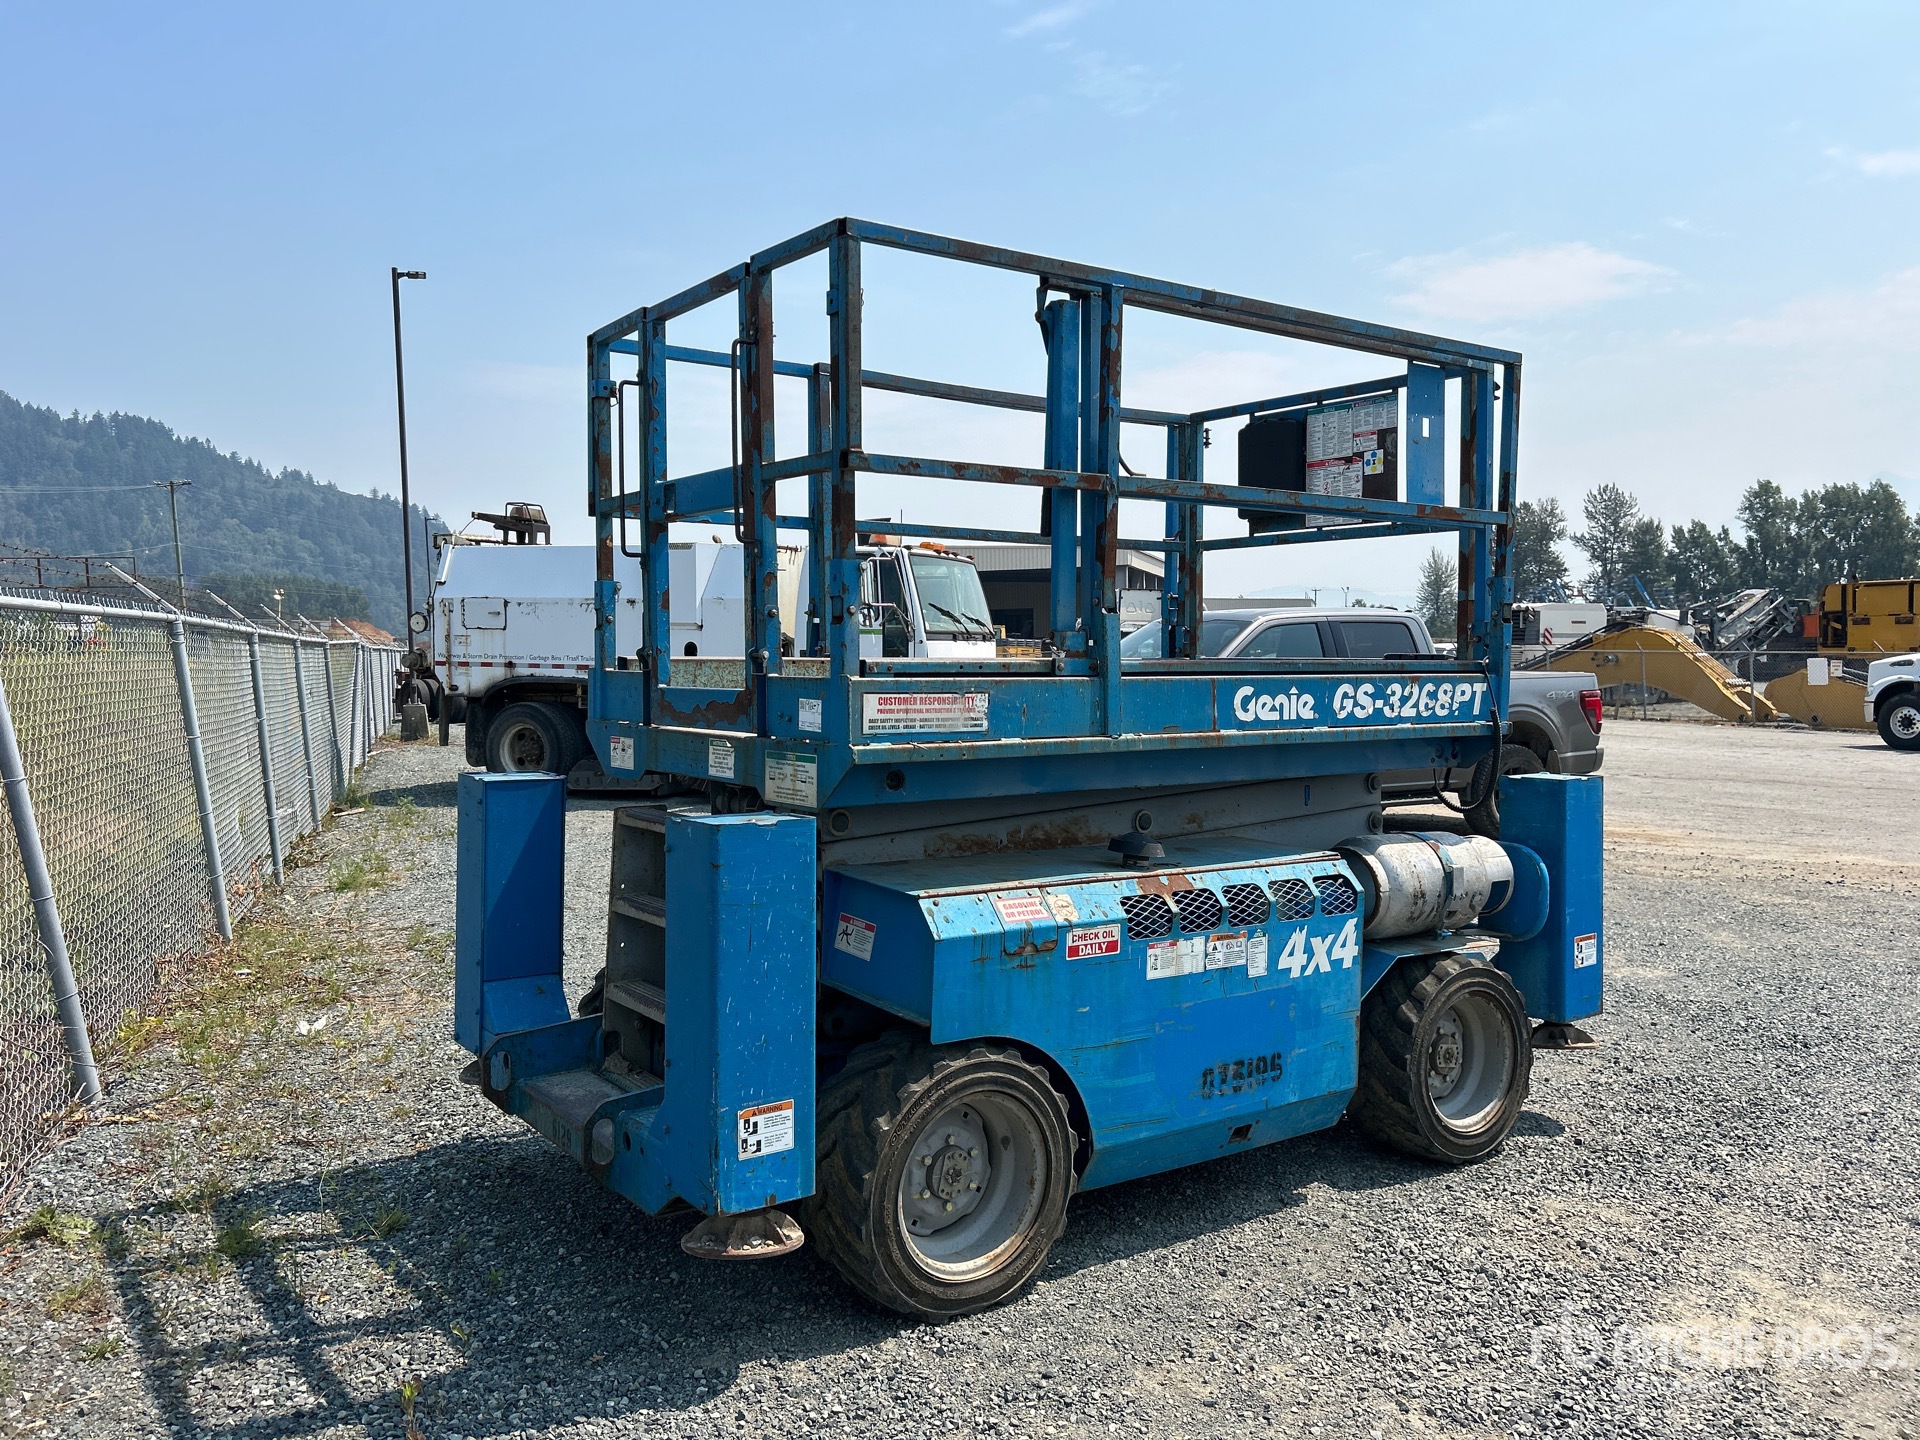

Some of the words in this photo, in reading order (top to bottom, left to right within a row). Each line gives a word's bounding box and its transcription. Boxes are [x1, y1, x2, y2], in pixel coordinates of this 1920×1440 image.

[437, 652, 461, 660] Warway
[498, 653, 525, 661] Protection
[529, 654, 550, 663] Garbage
[878, 696, 918, 706] CUSTOMER
[1233, 685, 1315, 722] Genie
[1002, 900, 1038, 910] GASOLINE
[1017, 909, 1044, 918] PETROL
[1072, 931, 1100, 944] CHECK
[1101, 929, 1115, 940] OIL
[1078, 942, 1108, 956] DAILY
[1277, 917, 1359, 979] 4x4
